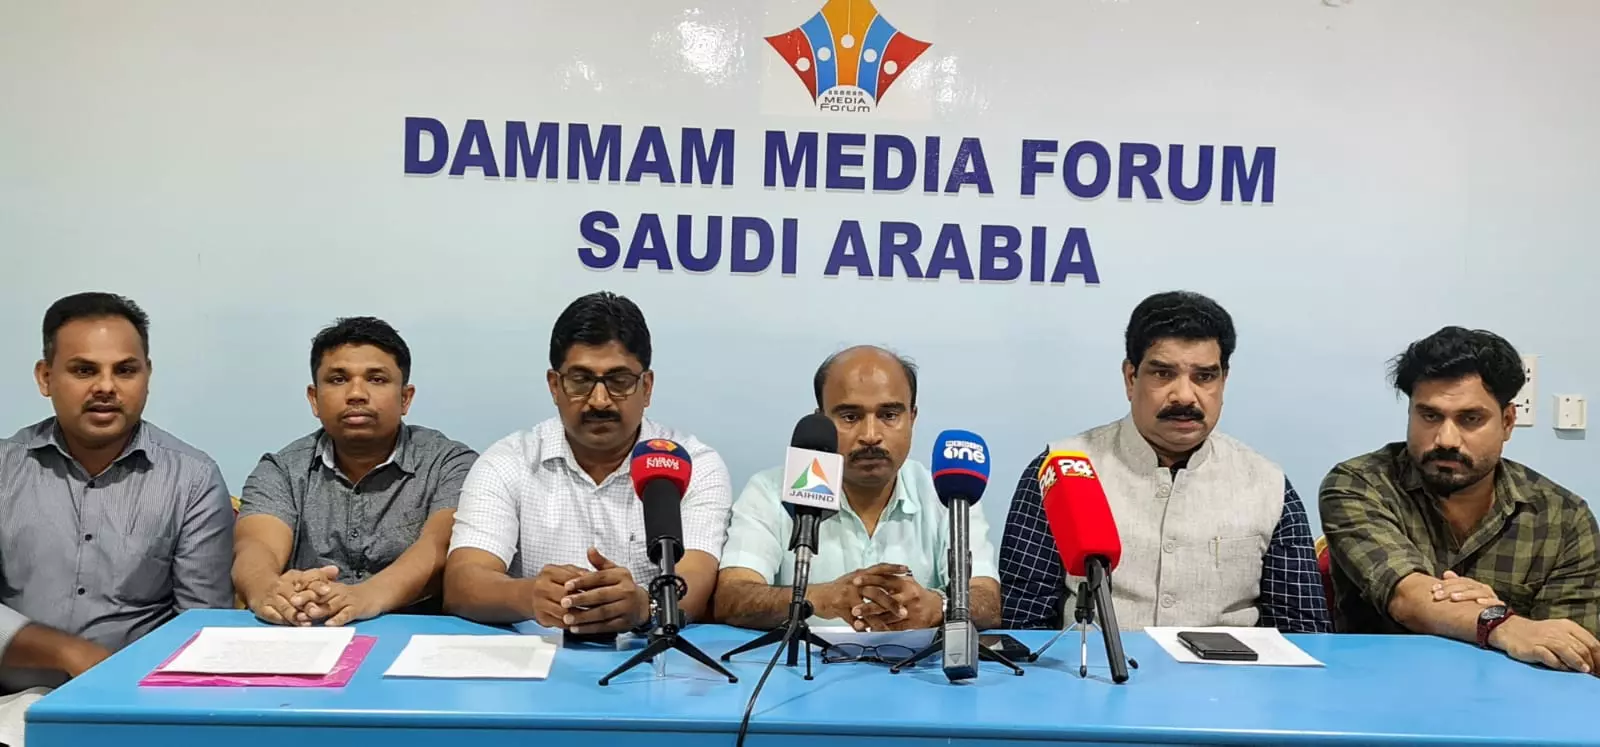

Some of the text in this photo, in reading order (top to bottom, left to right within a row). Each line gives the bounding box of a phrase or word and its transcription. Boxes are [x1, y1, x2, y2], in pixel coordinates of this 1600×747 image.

[824, 96, 866, 104] MEDIA
[820, 103, 870, 112] Forum
[404, 117, 1277, 204] DAMMAM MEDIA FORUM
[577, 210, 1100, 285] SAUDI ARABIA
[789, 490, 835, 502] JAIHIND
